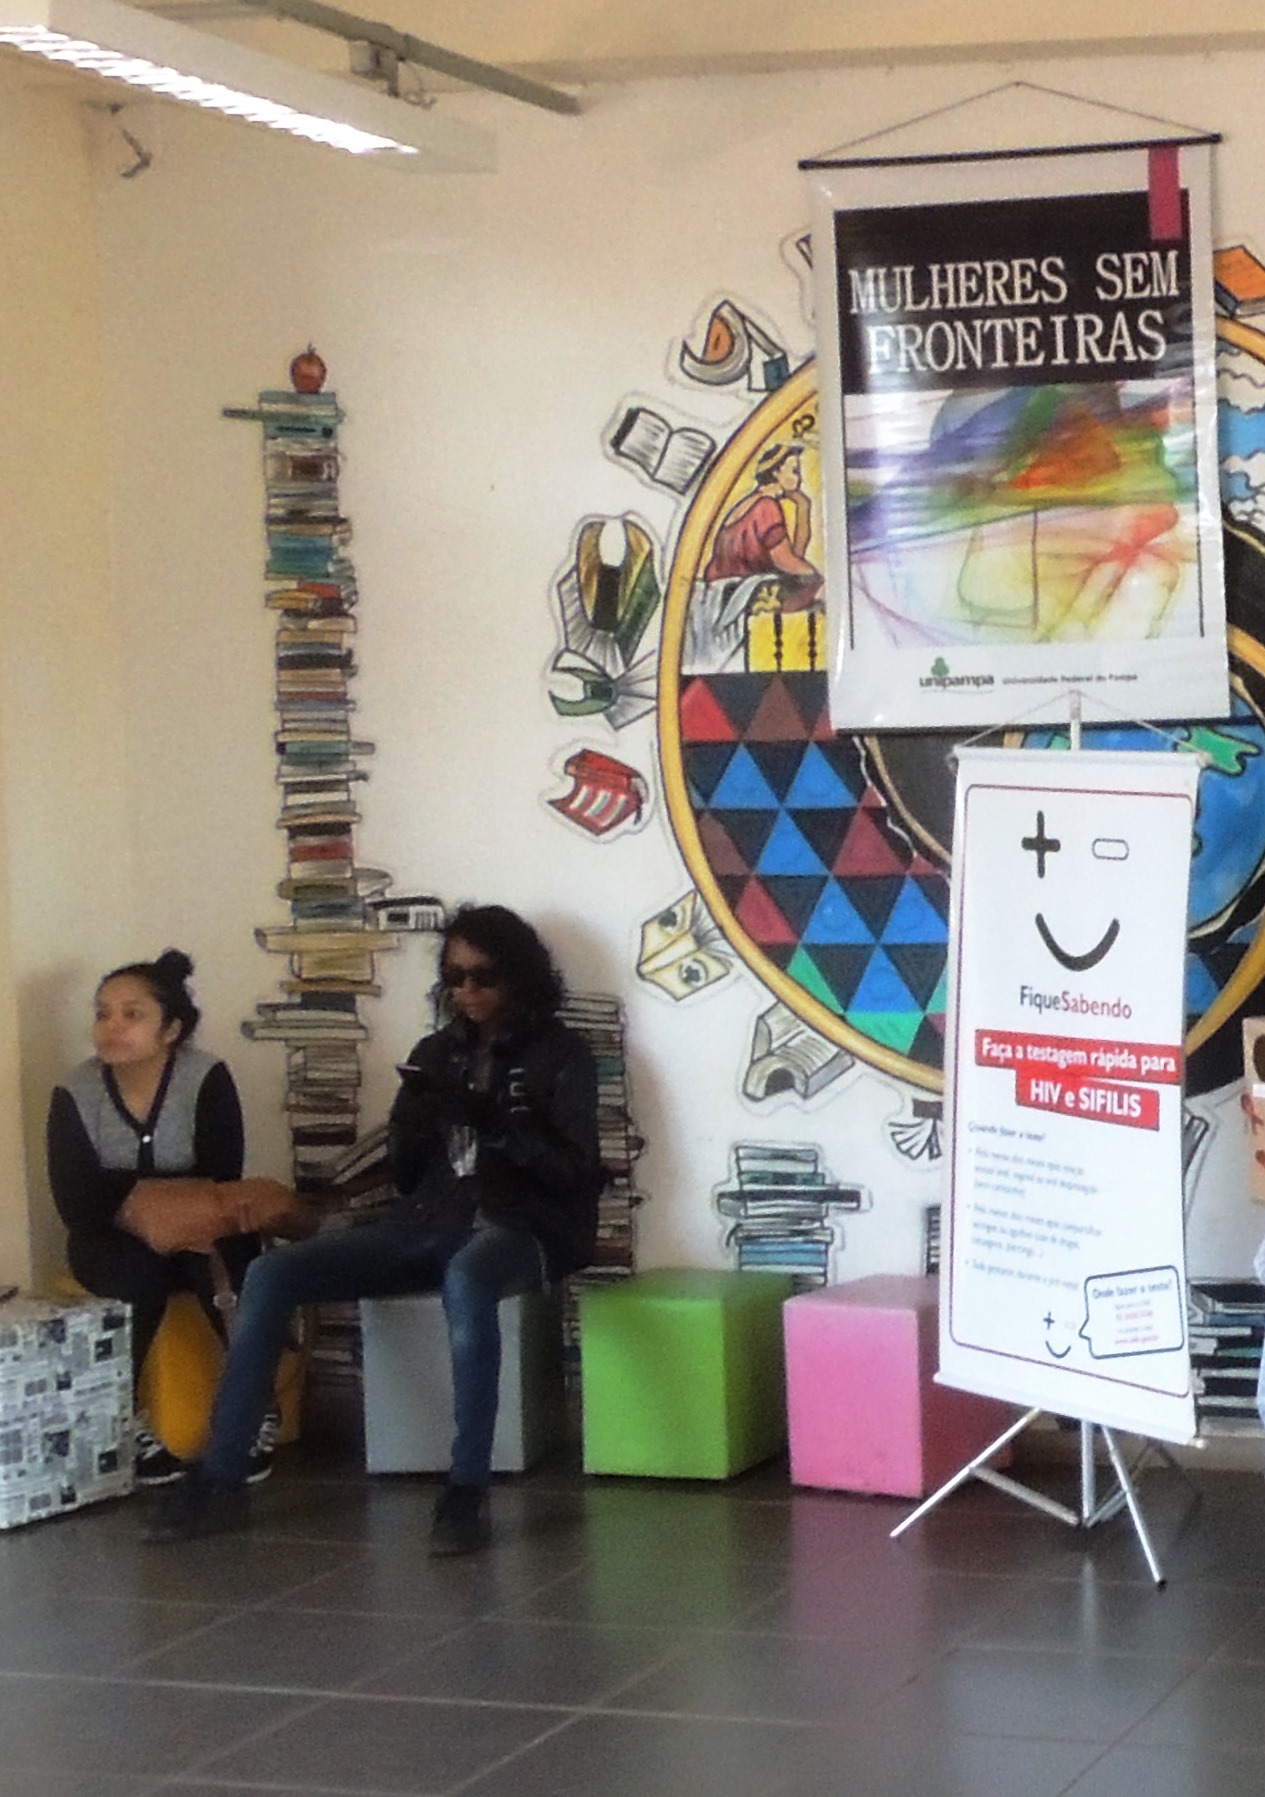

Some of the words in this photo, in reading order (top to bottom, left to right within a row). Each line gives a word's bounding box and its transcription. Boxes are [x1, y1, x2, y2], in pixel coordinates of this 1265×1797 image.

[849, 256, 1068, 315] MULHERES
[1095, 250, 1180, 300] SEM
[868, 309, 1167, 374] FRONTEIRAS
[919, 673, 995, 690] unipampa
[982, 1036, 1013, 1063] Faça
[1015, 1044, 1024, 1059] a
[1026, 1042, 1088, 1069] testagem
[1090, 1046, 1137, 1072] rápida
[1140, 1056, 1176, 1075] para
[1030, 1078, 1061, 1103] HIV
[1064, 1090, 1075, 1108] e
